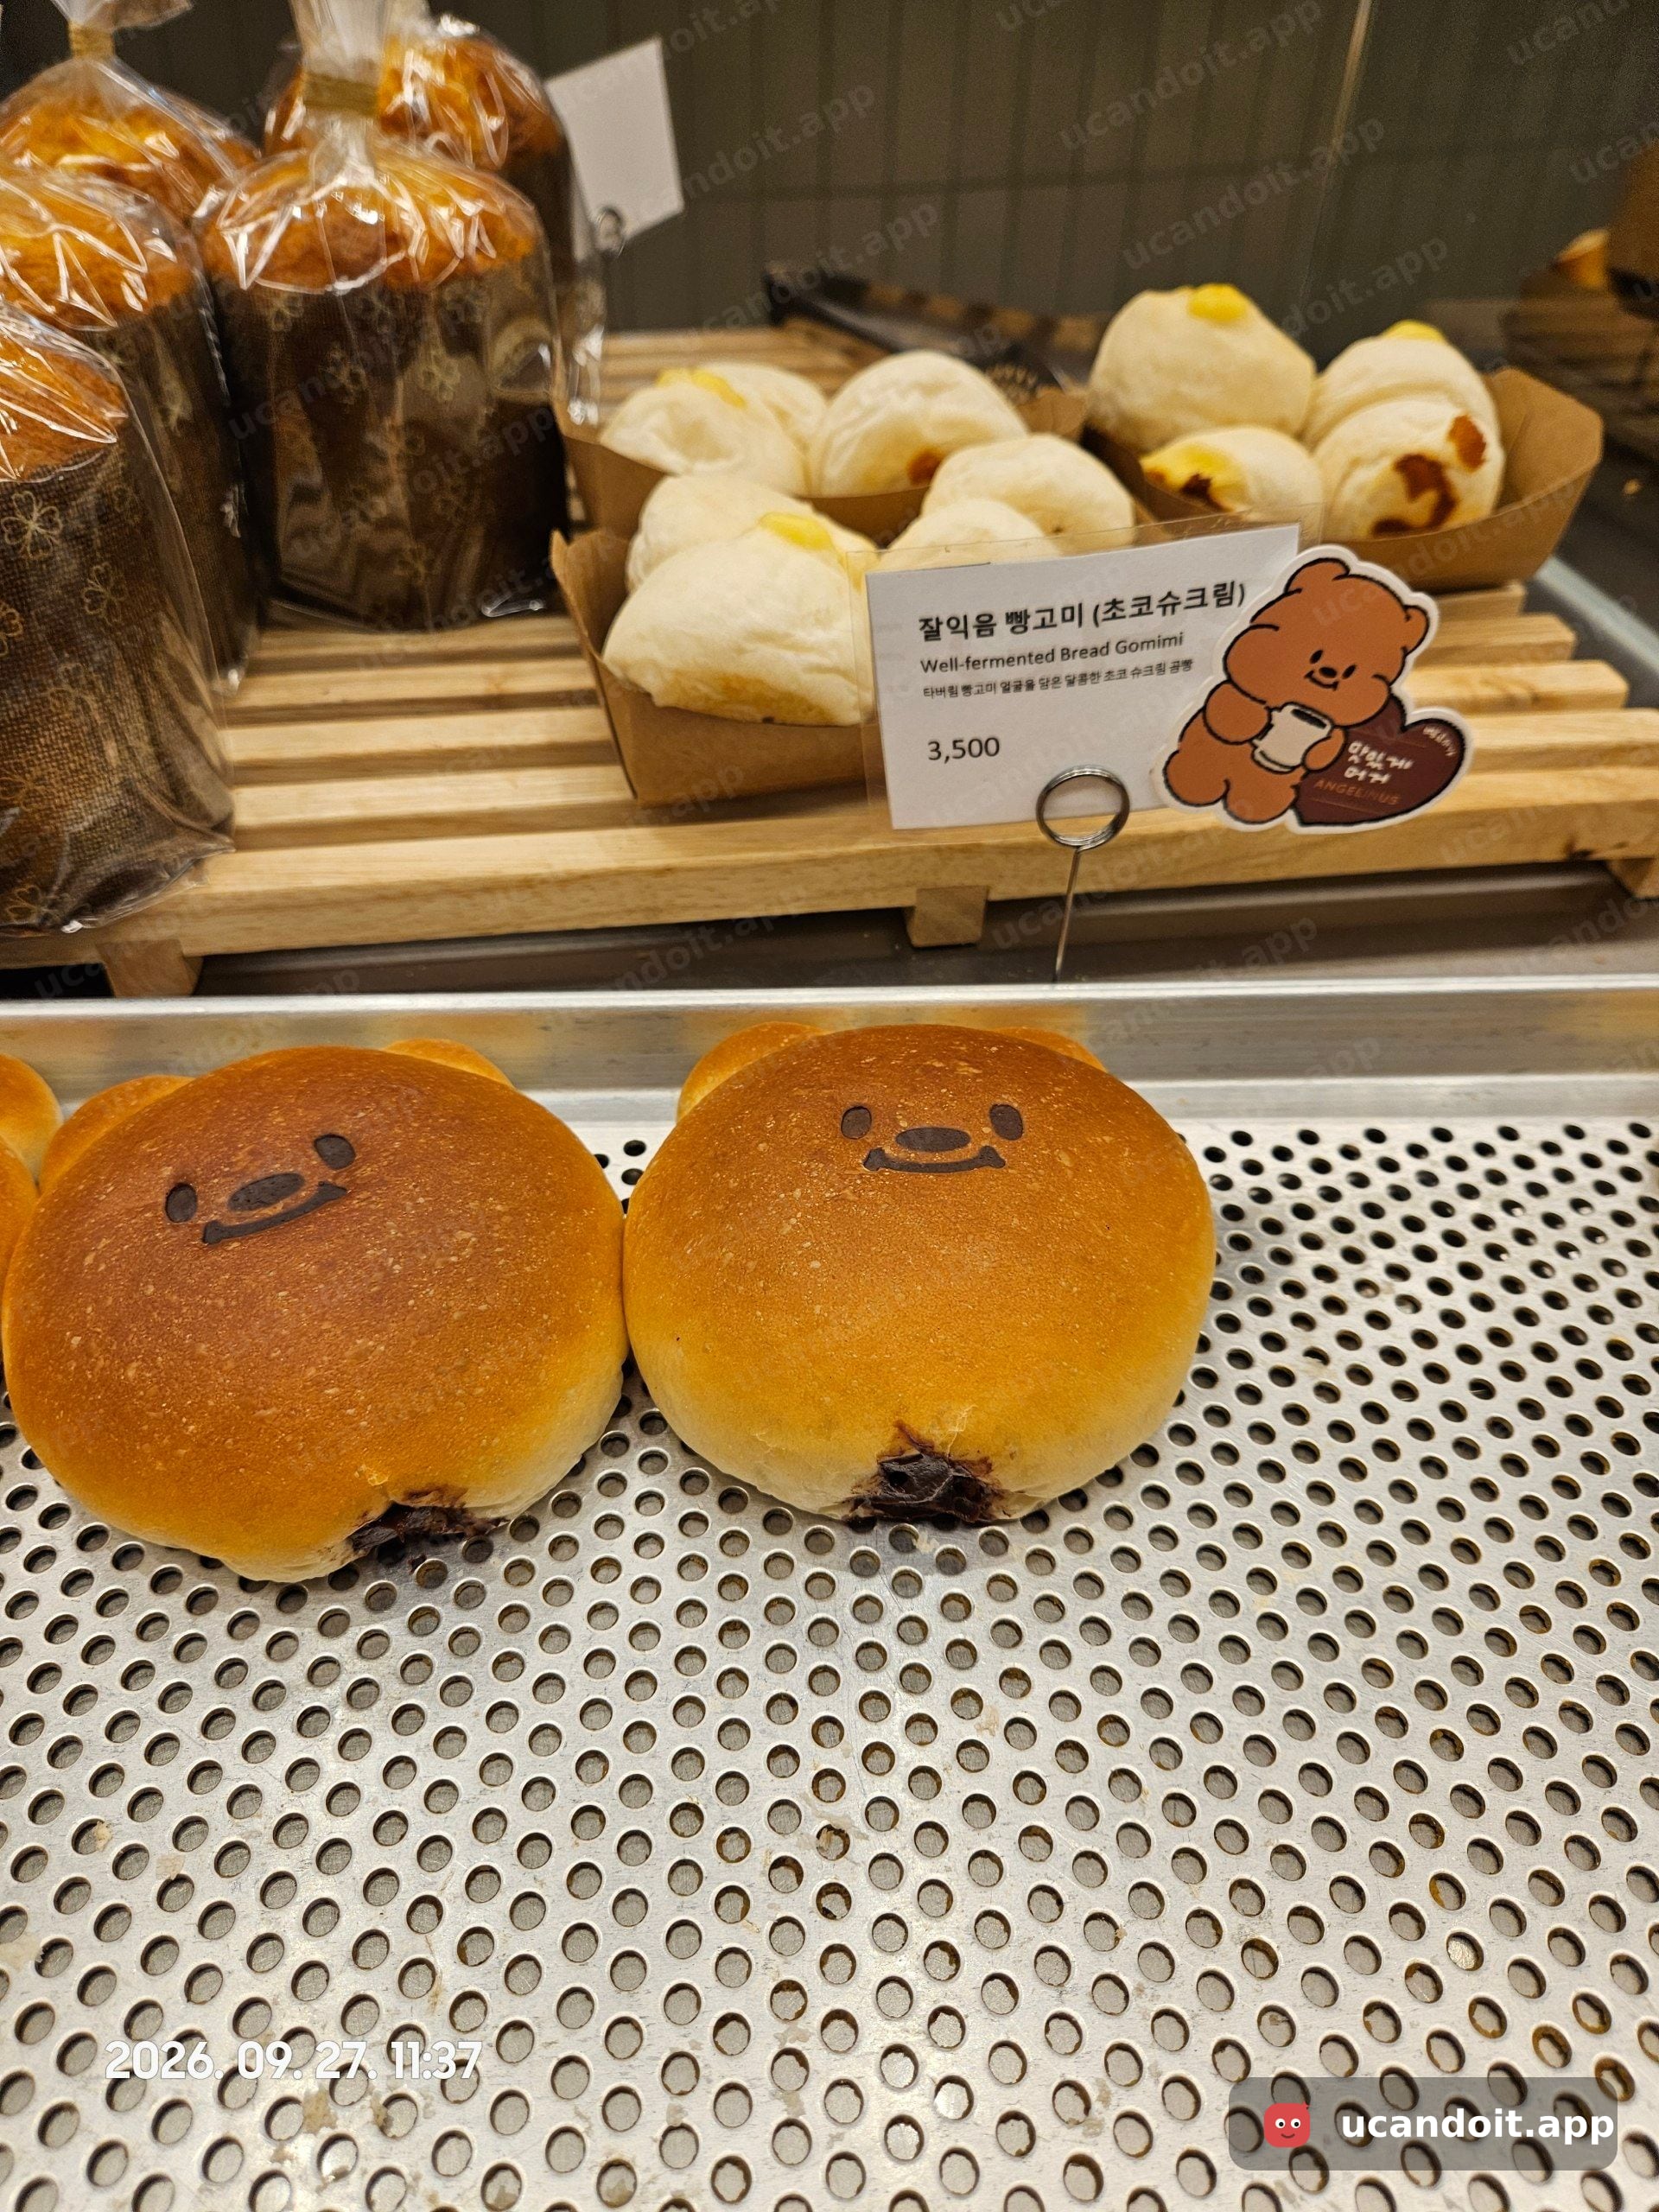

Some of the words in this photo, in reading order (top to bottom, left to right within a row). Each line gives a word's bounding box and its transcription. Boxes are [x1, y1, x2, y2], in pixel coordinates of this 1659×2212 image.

[918, 613, 997, 642] 잘익음
[1005, 602, 1084, 635] 빵고미
[1092, 581, 1246, 628] (초코슈크림)
[920, 648, 1055, 674] Well-fermented
[1060, 642, 1110, 662] Bread
[1116, 632, 1185, 655] Gomimi
[961, 681, 996, 697] 빵고미
[1039, 675, 1062, 690] 담은
[1065, 670, 1101, 688] 달콤한
[927, 736, 1001, 763] 3,500
[1348, 741, 1414, 770] 맛있게
